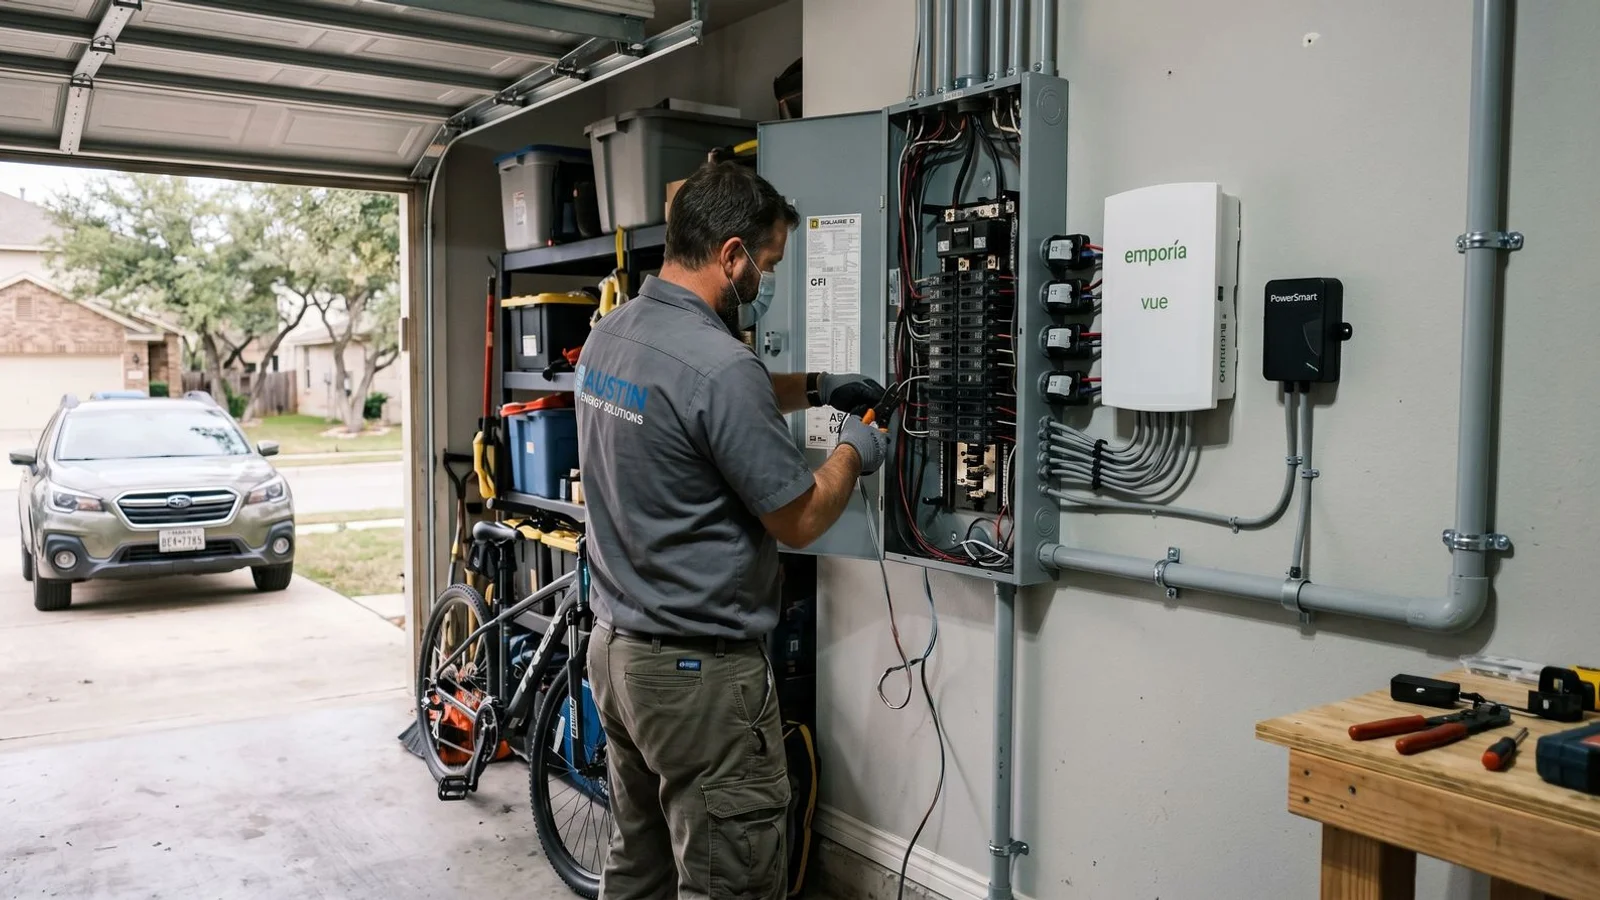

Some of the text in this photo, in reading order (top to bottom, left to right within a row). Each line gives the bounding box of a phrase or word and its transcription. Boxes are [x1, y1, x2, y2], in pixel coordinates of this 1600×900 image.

[1140, 296, 1169, 310] vue
[1270, 293, 1318, 303] PowerSmart
[584, 367, 649, 412] AUSTIN
[580, 391, 644, 426] ENERGY SOLUTIONS
